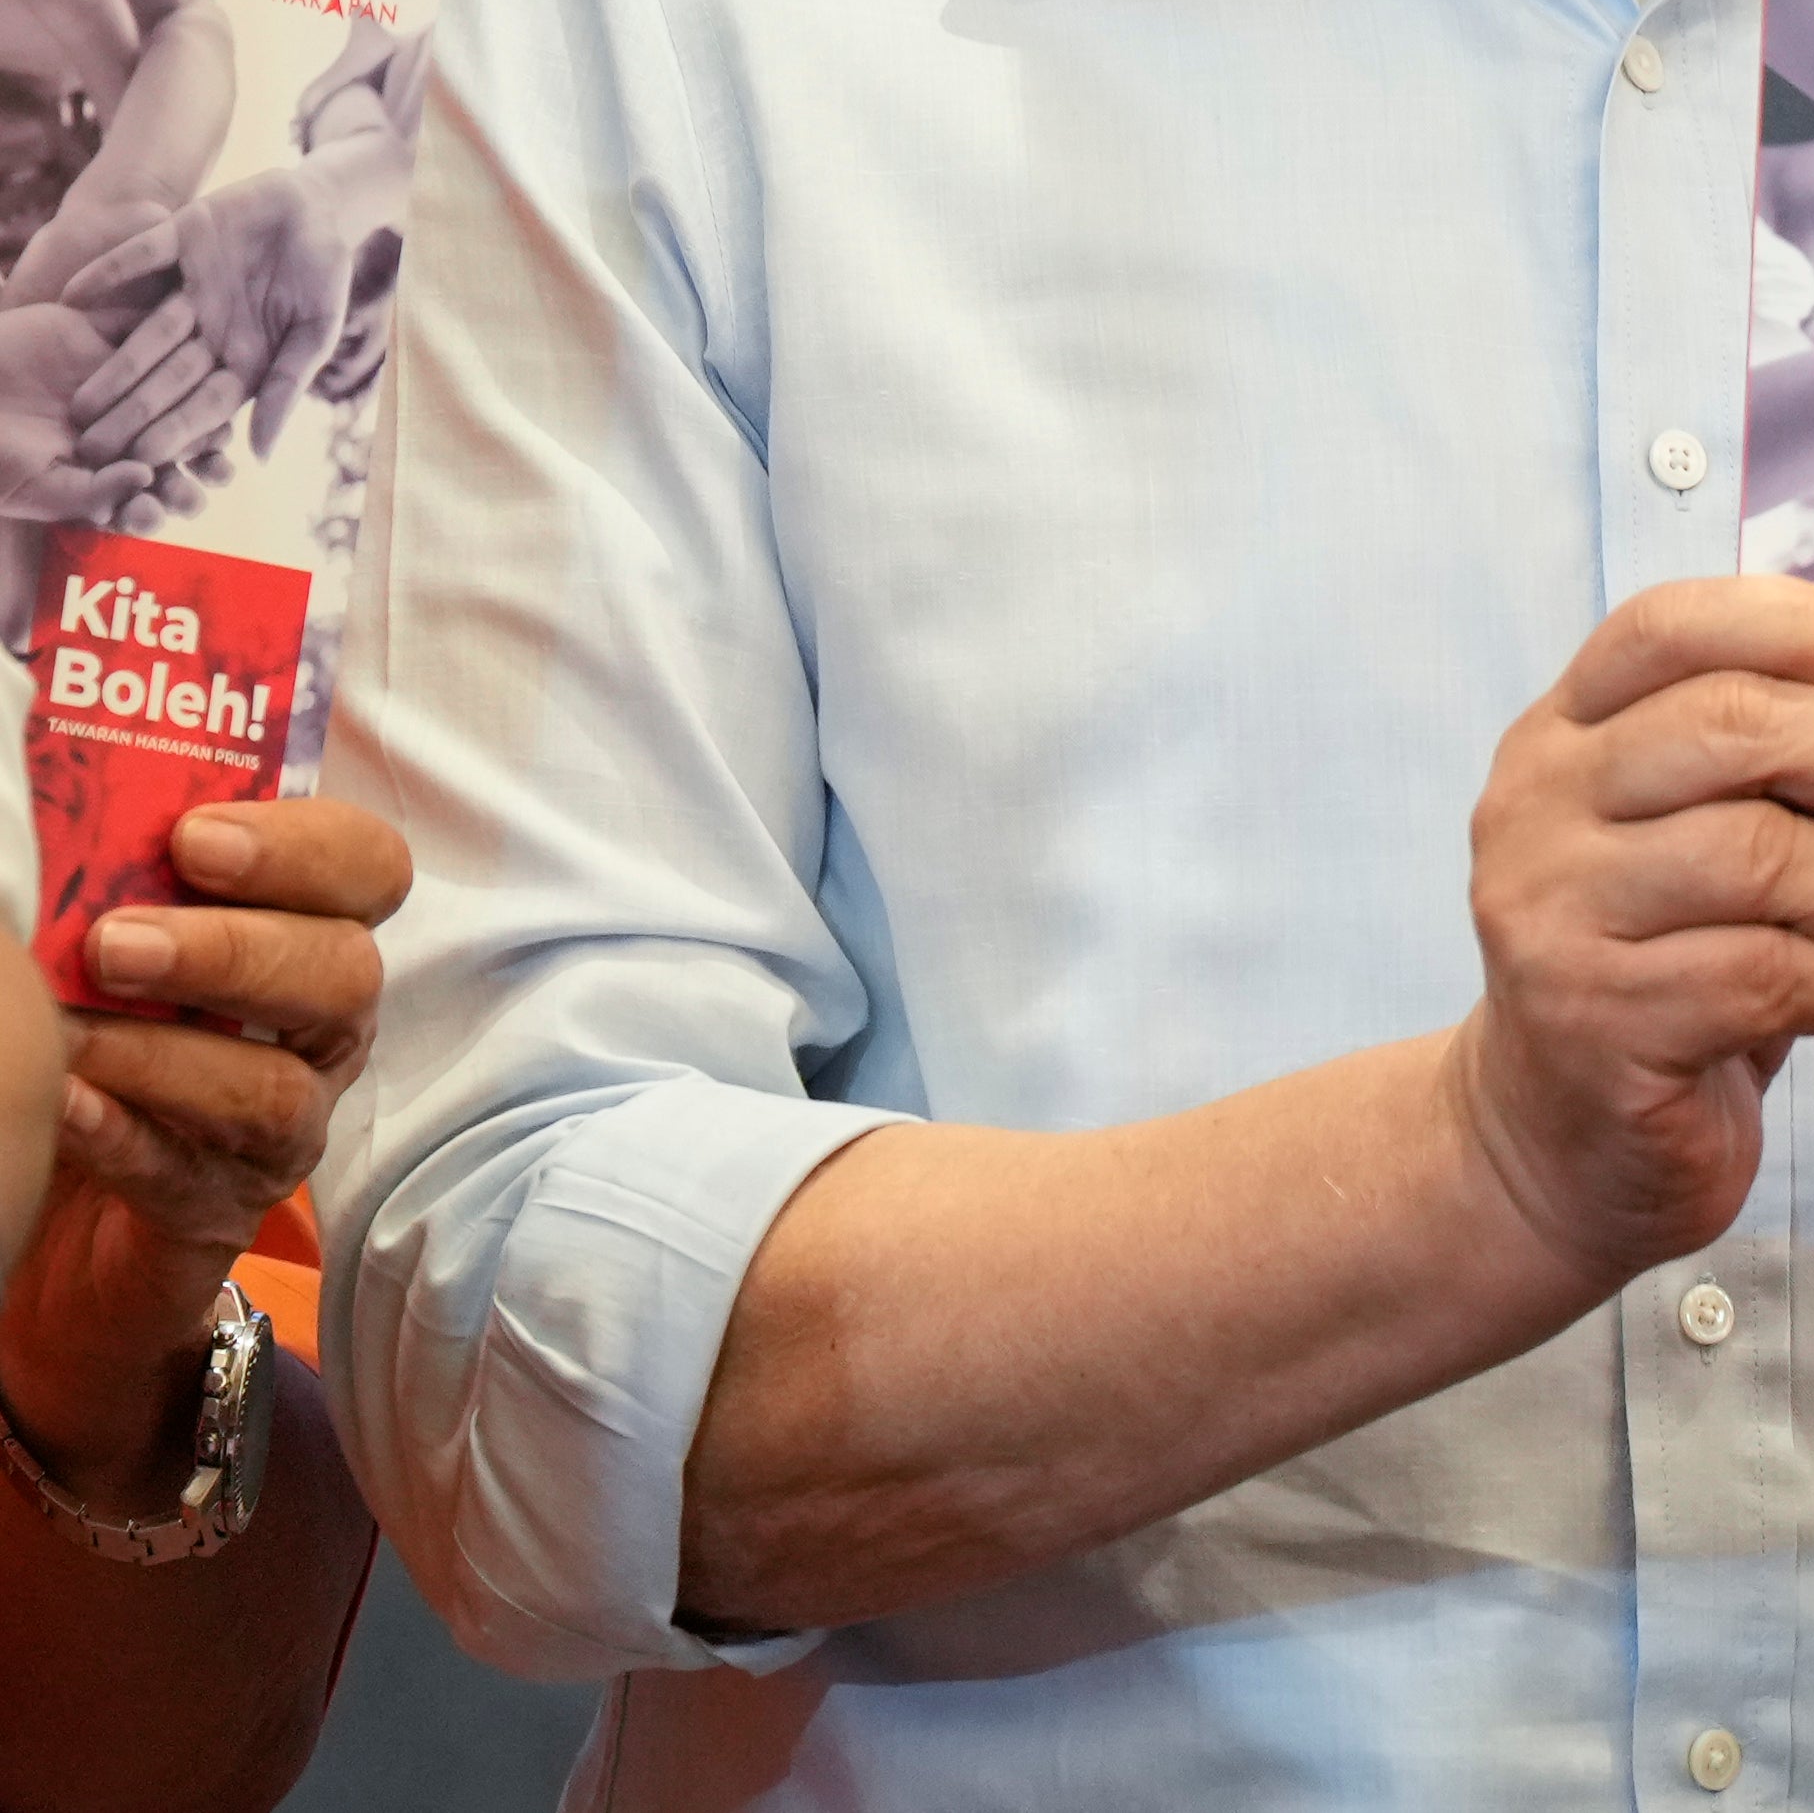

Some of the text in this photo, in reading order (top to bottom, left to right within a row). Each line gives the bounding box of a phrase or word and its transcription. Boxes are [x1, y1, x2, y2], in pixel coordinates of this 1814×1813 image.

[60, 574, 200, 655] Kita
[50, 645, 271, 742] Boleh!
[47, 717, 261, 772] TAWARAN HARAPAN PRU15
